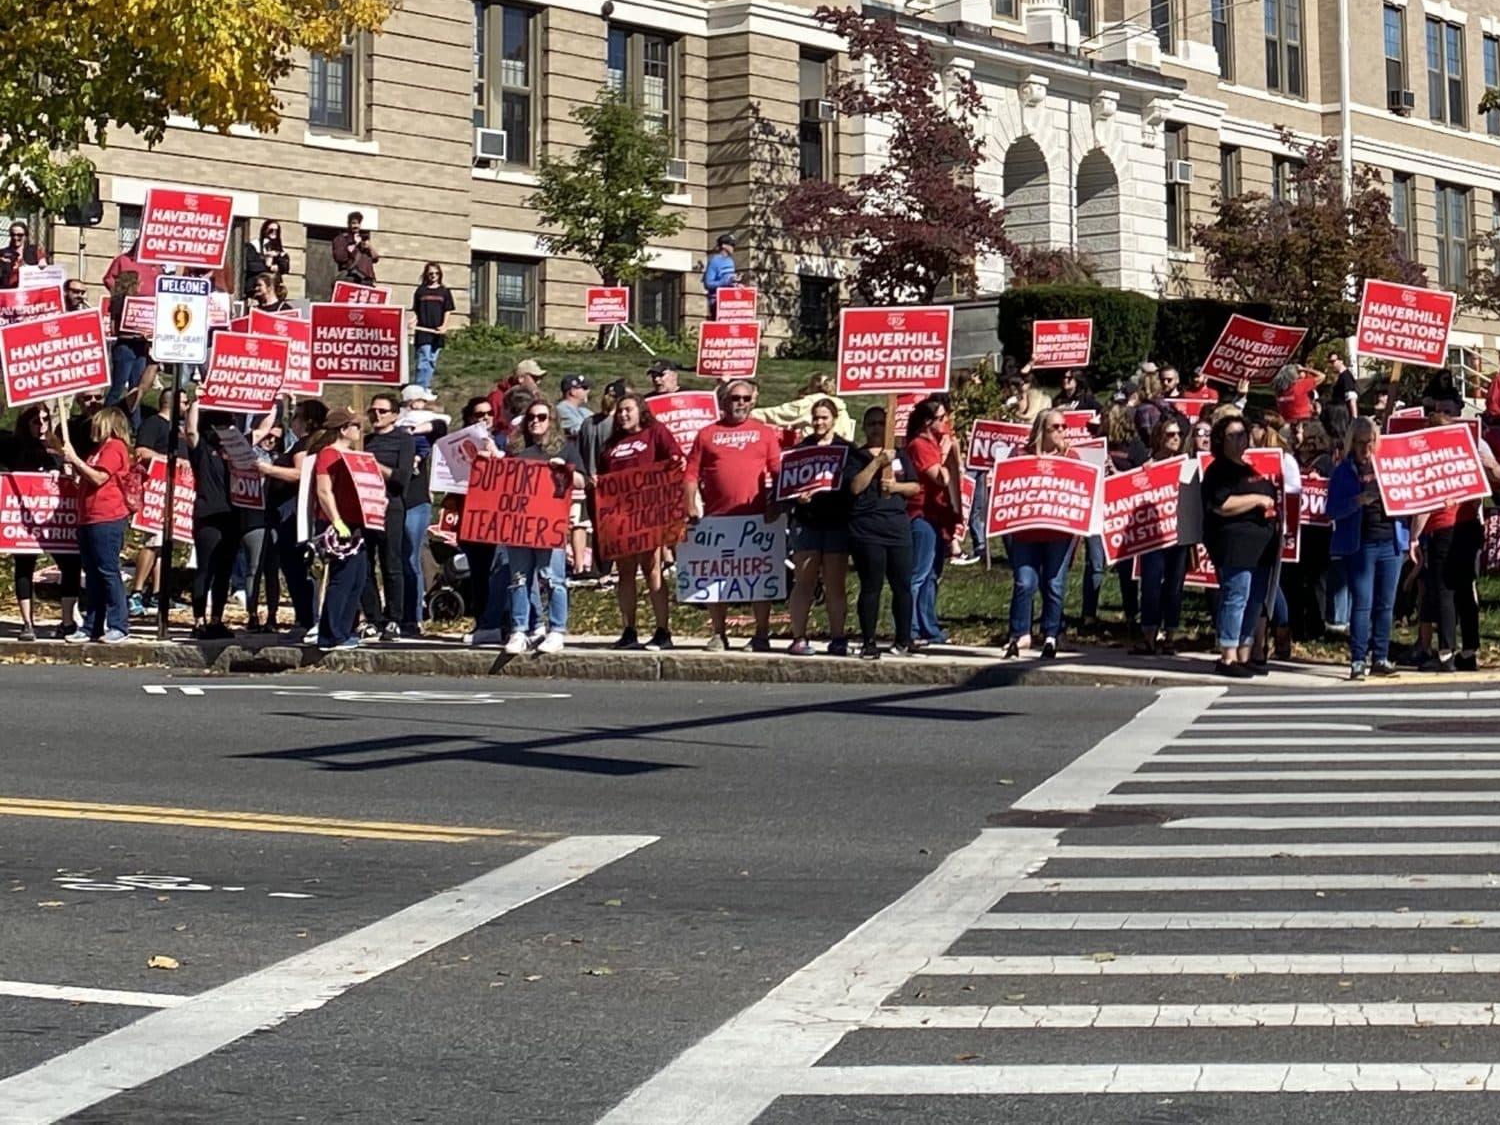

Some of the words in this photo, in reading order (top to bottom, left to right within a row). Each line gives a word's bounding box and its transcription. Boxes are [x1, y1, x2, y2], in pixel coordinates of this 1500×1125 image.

[152, 210, 224, 227] HAVERHILL
[146, 226, 225, 242] EDUCATORS
[146, 238, 166, 250] ON
[168, 241, 219, 255] STRIKE!
[162, 279, 206, 293] WELCOME
[1368, 302, 1445, 325] HAVERHILL
[316, 327, 396, 342] HAVERHILL
[1363, 316, 1446, 340] EDUCATORS
[10, 332, 98, 361] HAVERHILL
[849, 332, 942, 347] HAVERHILL
[1036, 342, 1088, 352] EDUCATORS
[1038, 333, 1087, 343] HAVERHILL
[1226, 335, 1290, 355] HAVERHILL
[1363, 330, 1386, 344] ON
[1388, 334, 1440, 355] STRIKE!
[313, 342, 398, 357] EDUCATORS
[843, 348, 945, 364] EDUCATORS
[1038, 353, 1051, 361] ON
[1216, 345, 1286, 367] EDUCATORS
[9, 347, 102, 376] EDUCATORS
[216, 355, 282, 372] HAVERHILL
[316, 358, 341, 371] ON
[341, 359, 395, 372] STRIKE!
[703, 360, 720, 369] ON
[1212, 358, 1234, 372] ON
[14, 375, 39, 391] ON
[41, 362, 100, 386] STRIKE!
[210, 371, 282, 386] EDUCATORS
[846, 366, 872, 380] ON
[873, 365, 940, 379] STRIKE!
[207, 384, 228, 397] ON
[229, 386, 276, 402] STRIKE!
[991, 432, 1029, 444] CONTRAC
[1380, 444, 1469, 471] HAVERHILL
[471, 458, 545, 497] SUPPORT
[783, 462, 839, 488] NOW
[1381, 458, 1477, 486] EDUCATORS
[999, 476, 1089, 495] HAVERHILL
[1388, 483, 1414, 501] ON
[1415, 473, 1478, 496] STRIKE!
[6, 495, 78, 508] HAVERHI
[498, 493, 529, 513] OUR
[993, 490, 1091, 508] EDUCATORS
[1, 510, 77, 524] EDUCATO
[995, 507, 1019, 521] ON
[1021, 503, 1084, 521] STRIKE!
[1104, 499, 1178, 532] EDUCATO
[3, 526, 28, 538] ON
[32, 526, 77, 540] STRIK
[467, 509, 565, 547] TEACHERS
[739, 521, 774, 552] Pay
[1111, 529, 1135, 548] ON
[689, 556, 773, 576] TEACHERS
[695, 575, 779, 600] STAYS
